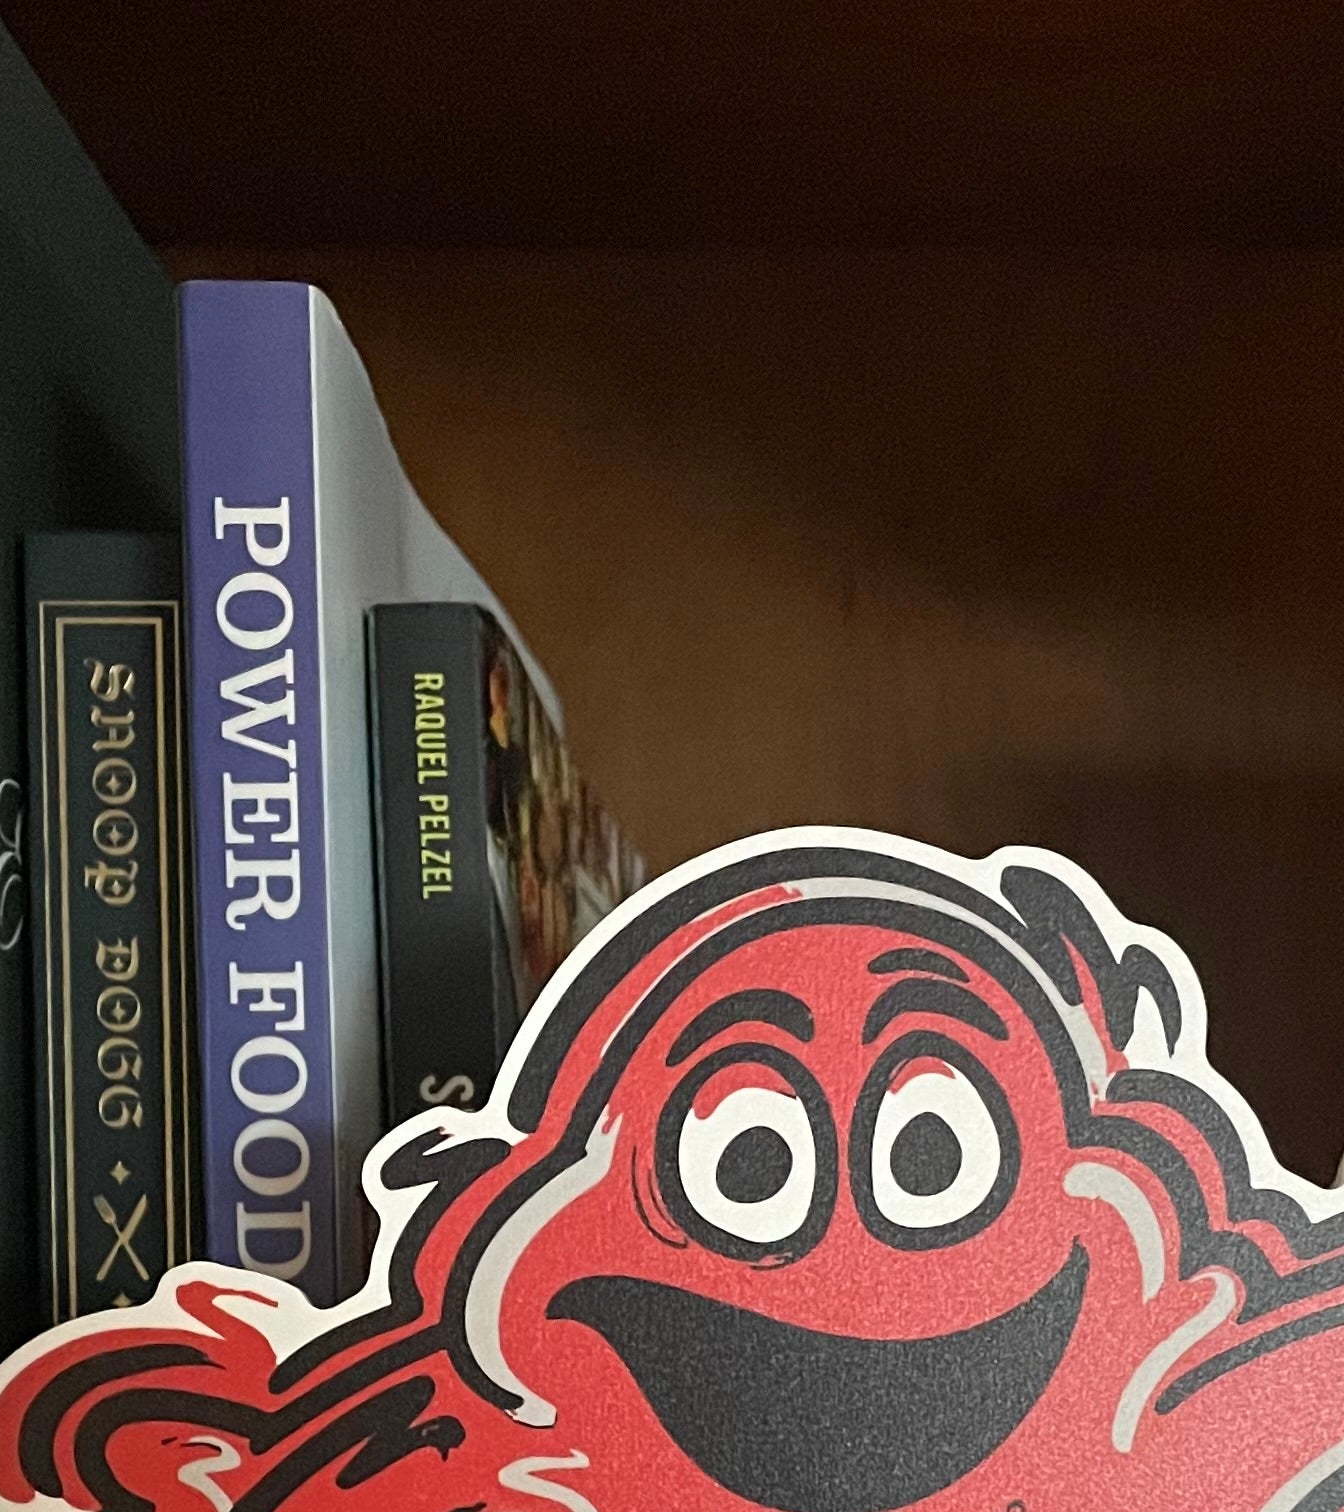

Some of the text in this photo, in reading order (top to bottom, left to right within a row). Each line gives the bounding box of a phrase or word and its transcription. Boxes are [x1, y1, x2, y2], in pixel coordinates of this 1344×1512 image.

[82, 657, 143, 1131] SNOOP DOGG
[213, 496, 312, 1282] POWER FOOD
[413, 671, 453, 900] RAQUEL PELZEL
